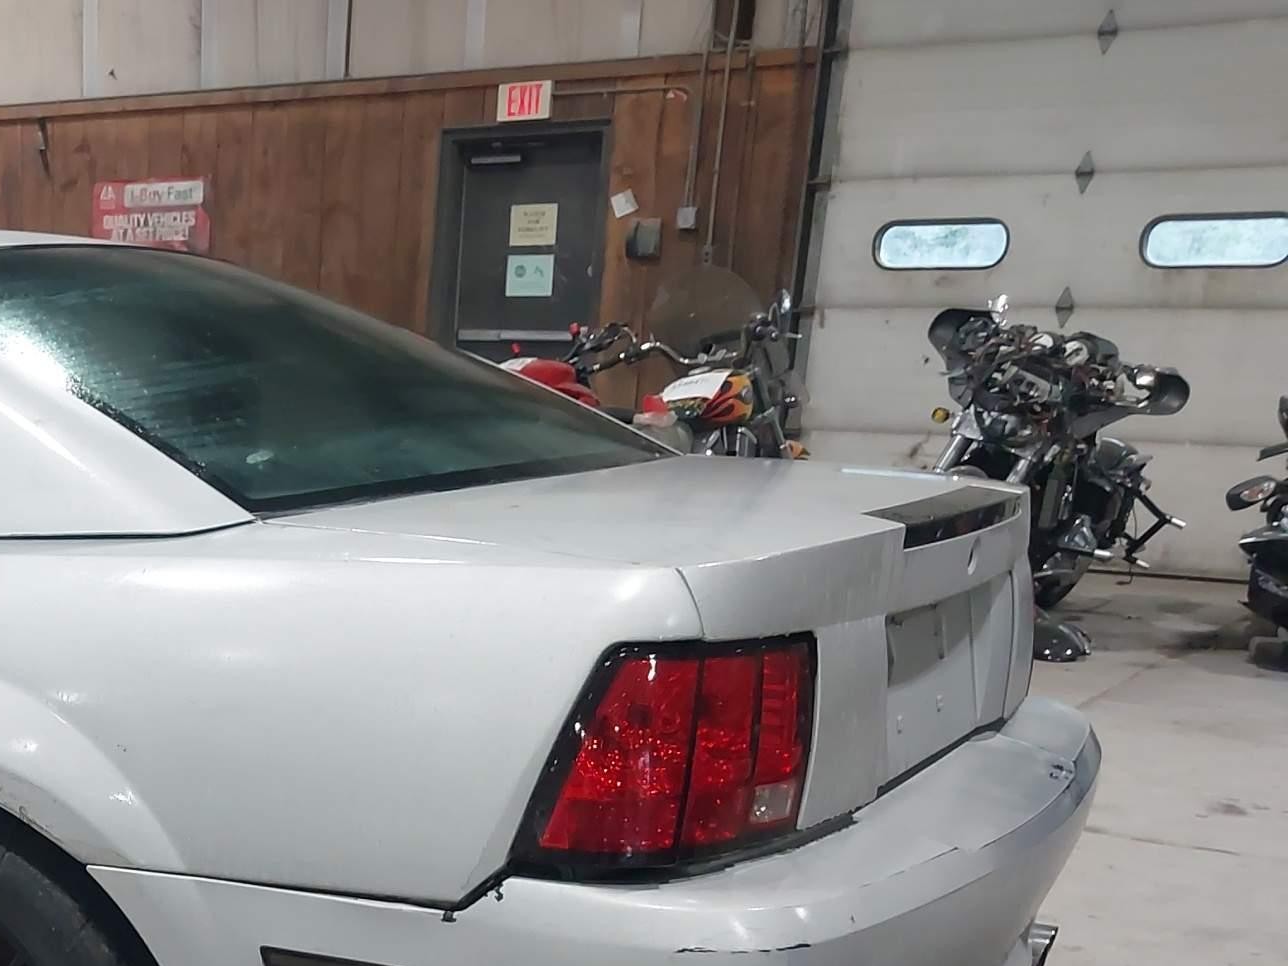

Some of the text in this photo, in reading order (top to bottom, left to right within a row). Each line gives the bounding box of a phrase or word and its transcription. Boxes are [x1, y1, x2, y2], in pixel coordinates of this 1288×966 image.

[507, 83, 543, 117] EXIT
[167, 185, 194, 201] Fast
[104, 211, 196, 229] QUALITY VEHICLES
